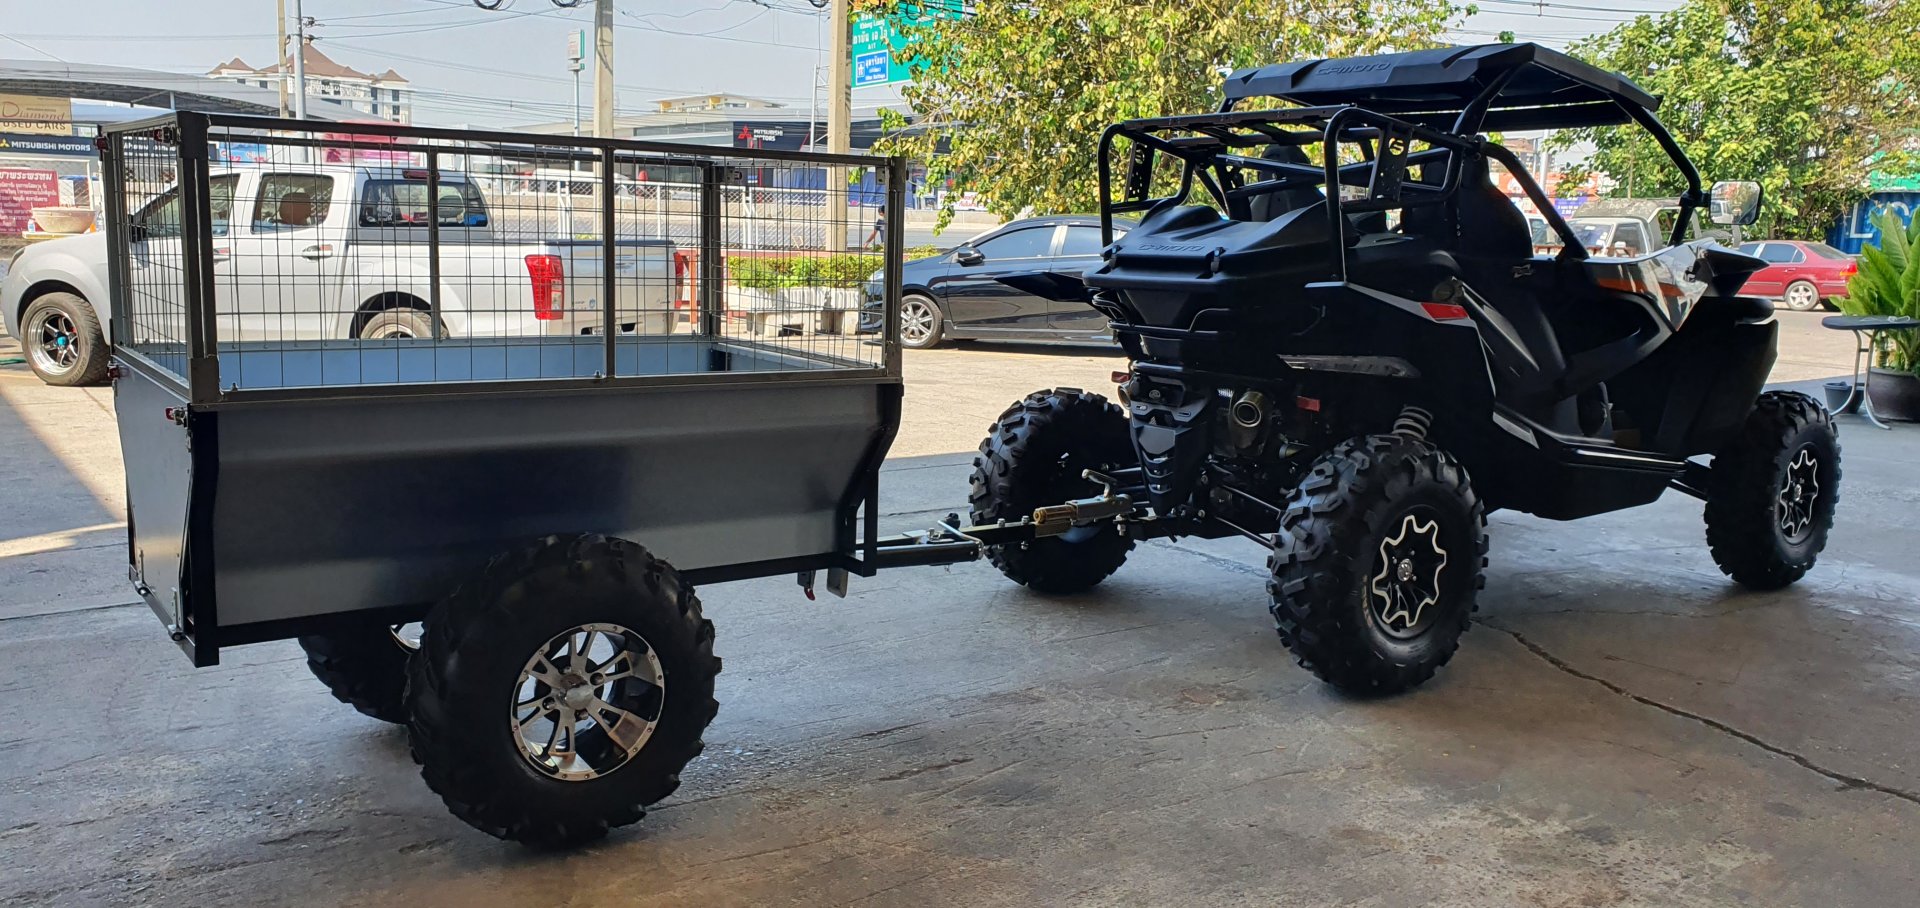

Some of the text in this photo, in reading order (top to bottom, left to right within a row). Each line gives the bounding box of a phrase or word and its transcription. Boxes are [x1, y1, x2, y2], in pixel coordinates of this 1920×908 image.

[3, 101, 66, 120] Diamond
[36, 120, 66, 130] CARS
[11, 141, 91, 152] MITSUBISHI MOTORS
